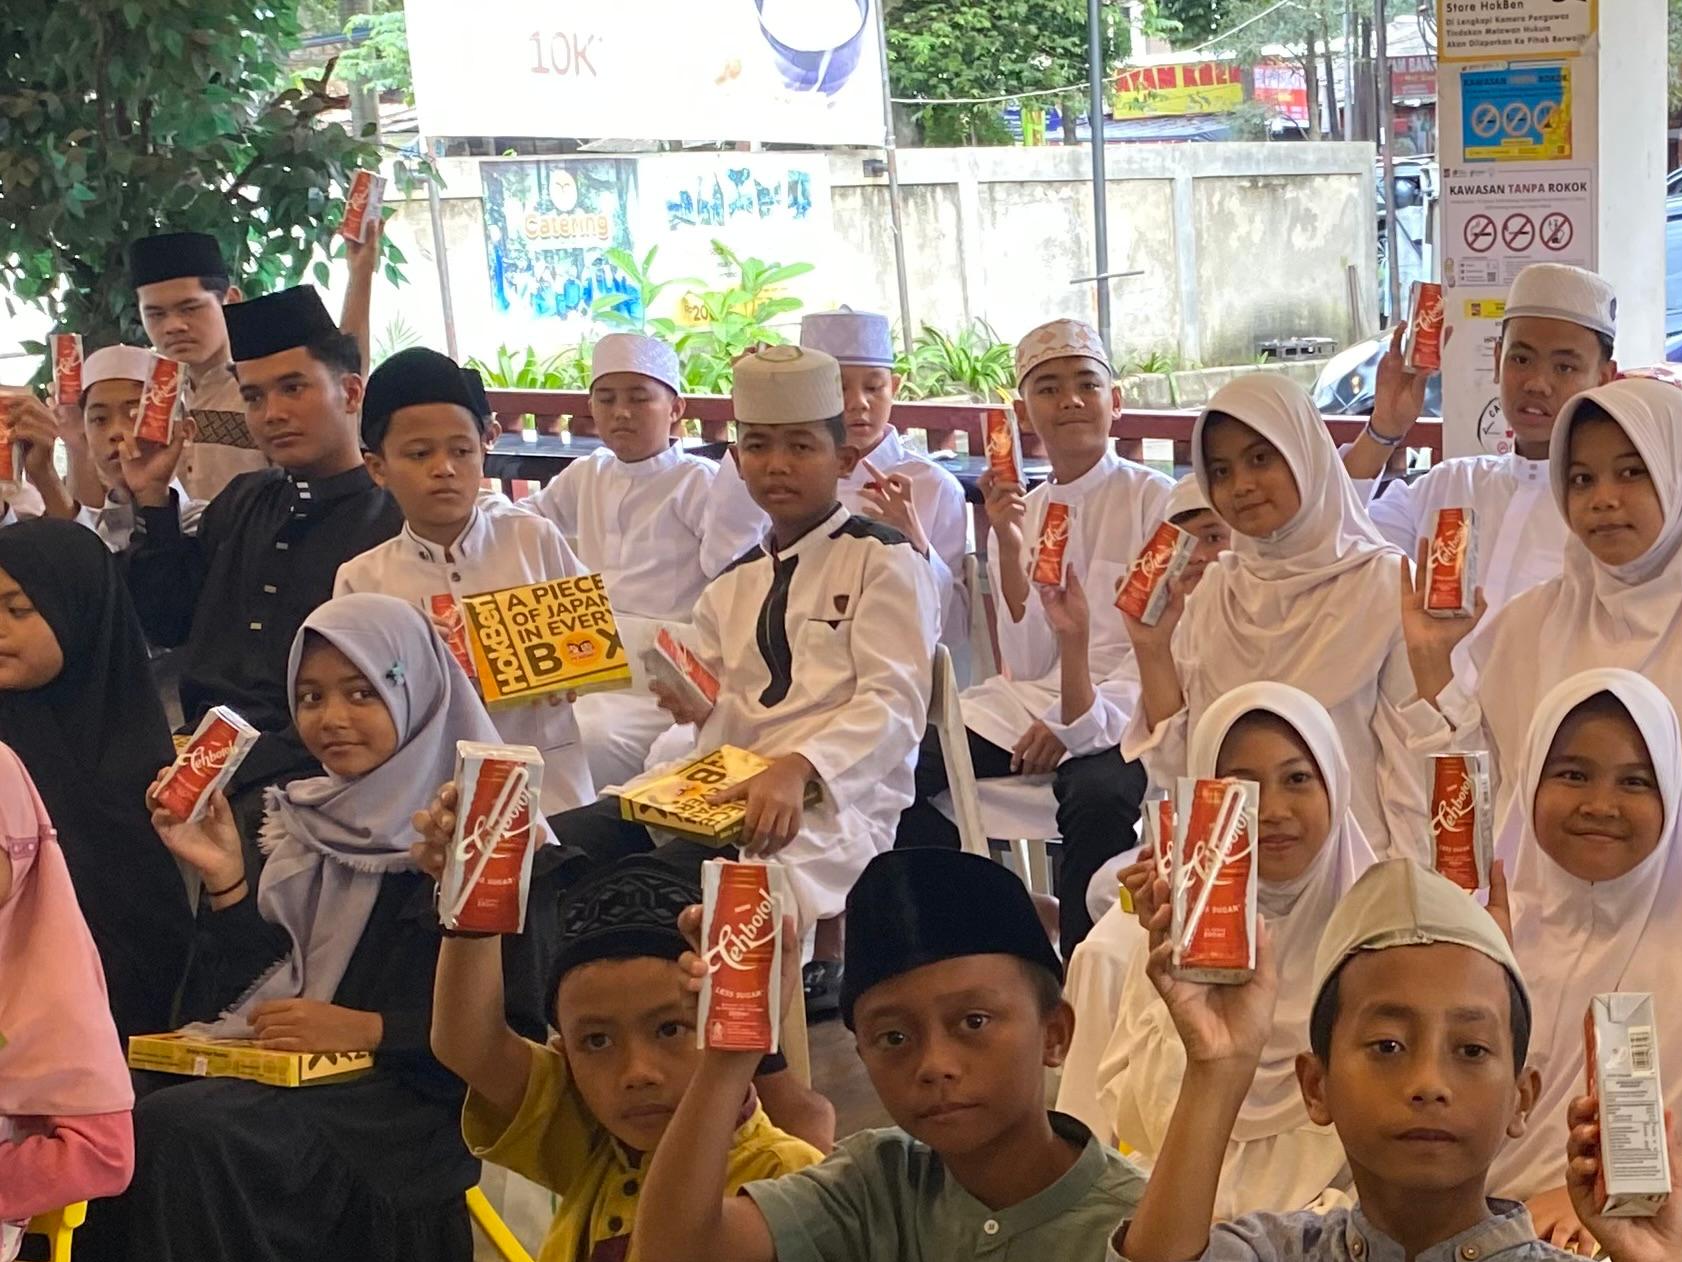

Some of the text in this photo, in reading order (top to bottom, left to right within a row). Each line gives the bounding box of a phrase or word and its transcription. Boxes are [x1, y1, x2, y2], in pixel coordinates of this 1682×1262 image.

[1446, 1, 1524, 13] Store HokBen
[1450, 182, 1587, 195] KAWASAN TANPA ROKOK
[524, 213, 609, 240] Catering
[507, 574, 605, 612] A PIECE
[511, 608, 541, 627] OF
[474, 594, 528, 694] HokBen
[517, 625, 543, 644] IN
[1431, 772, 1477, 837] Tehbotol
[702, 888, 784, 975] Tehbotol
[715, 988, 762, 1000] LESS SUGAR
